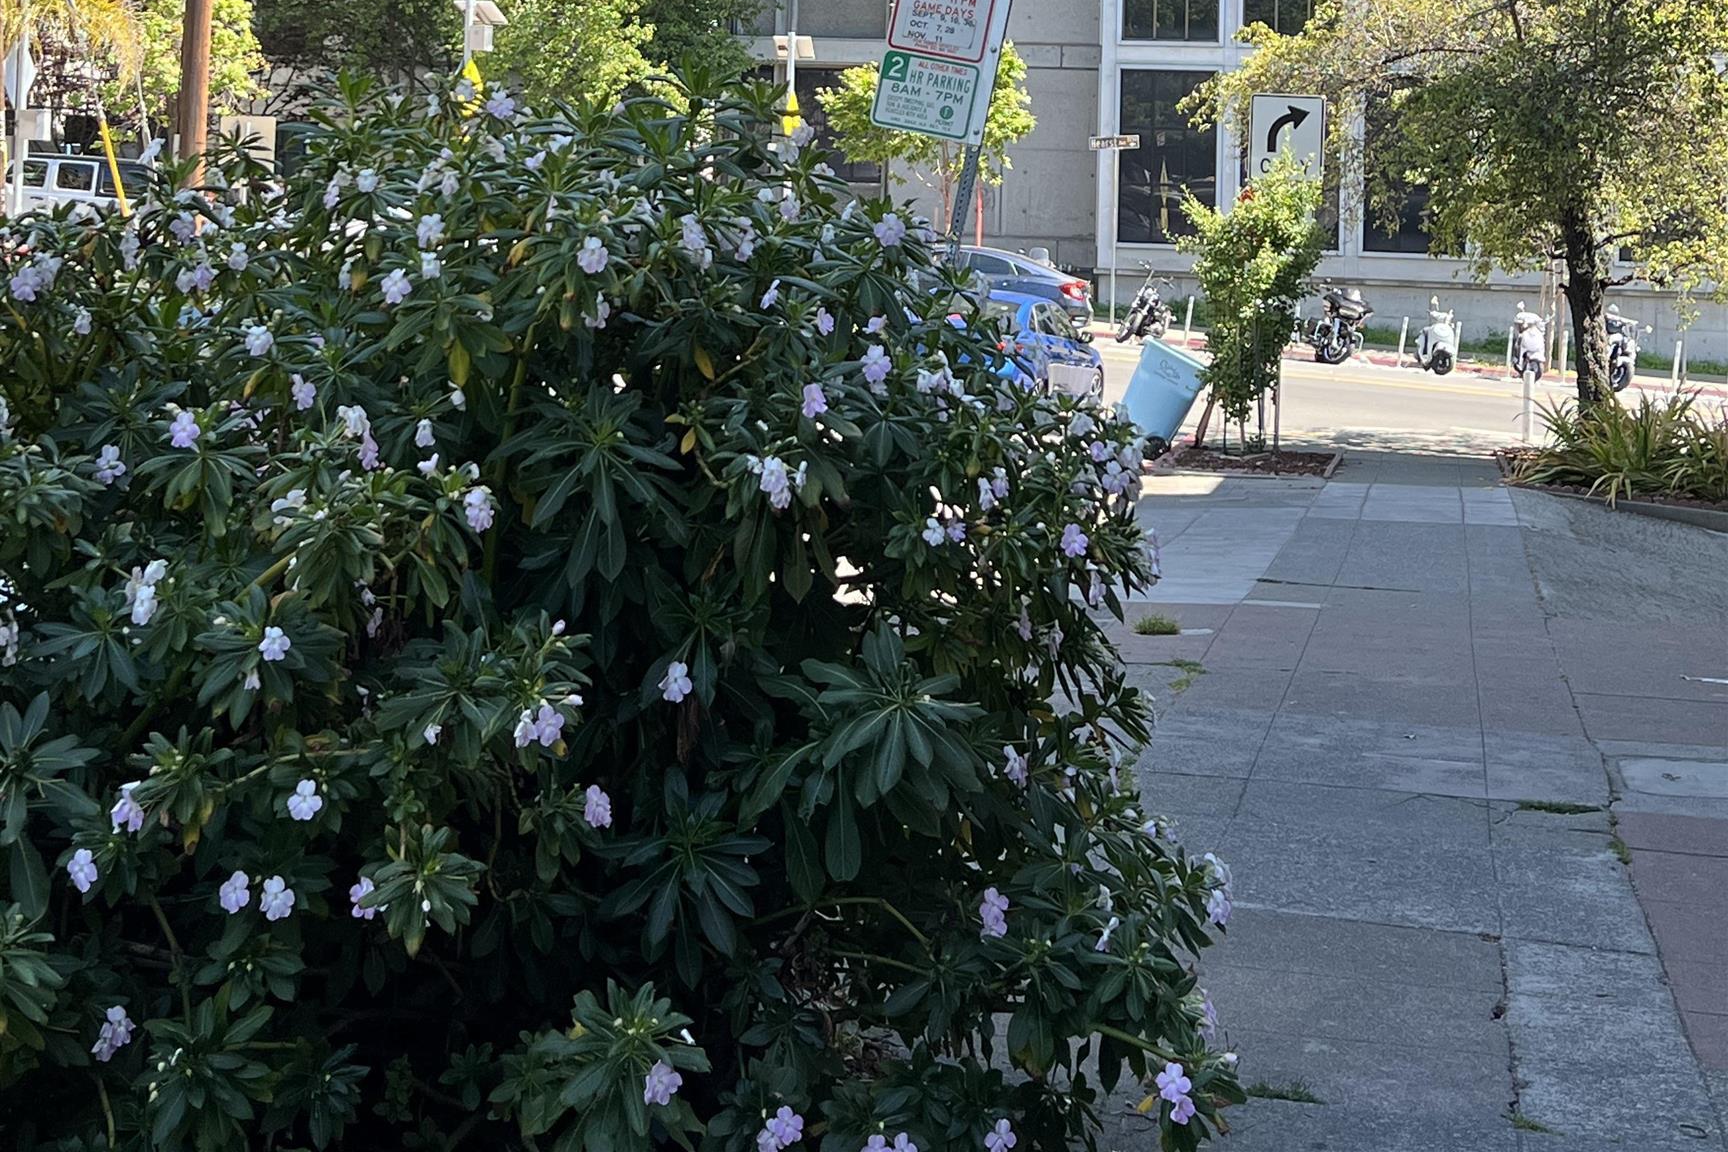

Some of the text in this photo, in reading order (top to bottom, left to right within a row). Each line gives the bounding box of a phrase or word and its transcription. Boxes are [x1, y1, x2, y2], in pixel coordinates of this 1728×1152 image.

[913, 0, 974, 19] GAME DAYS
[888, 56, 904, 77] 2
[909, 69, 971, 93] HR PARKING
[891, 82, 922, 97] 8AM
[935, 90, 964, 105] 7PM
